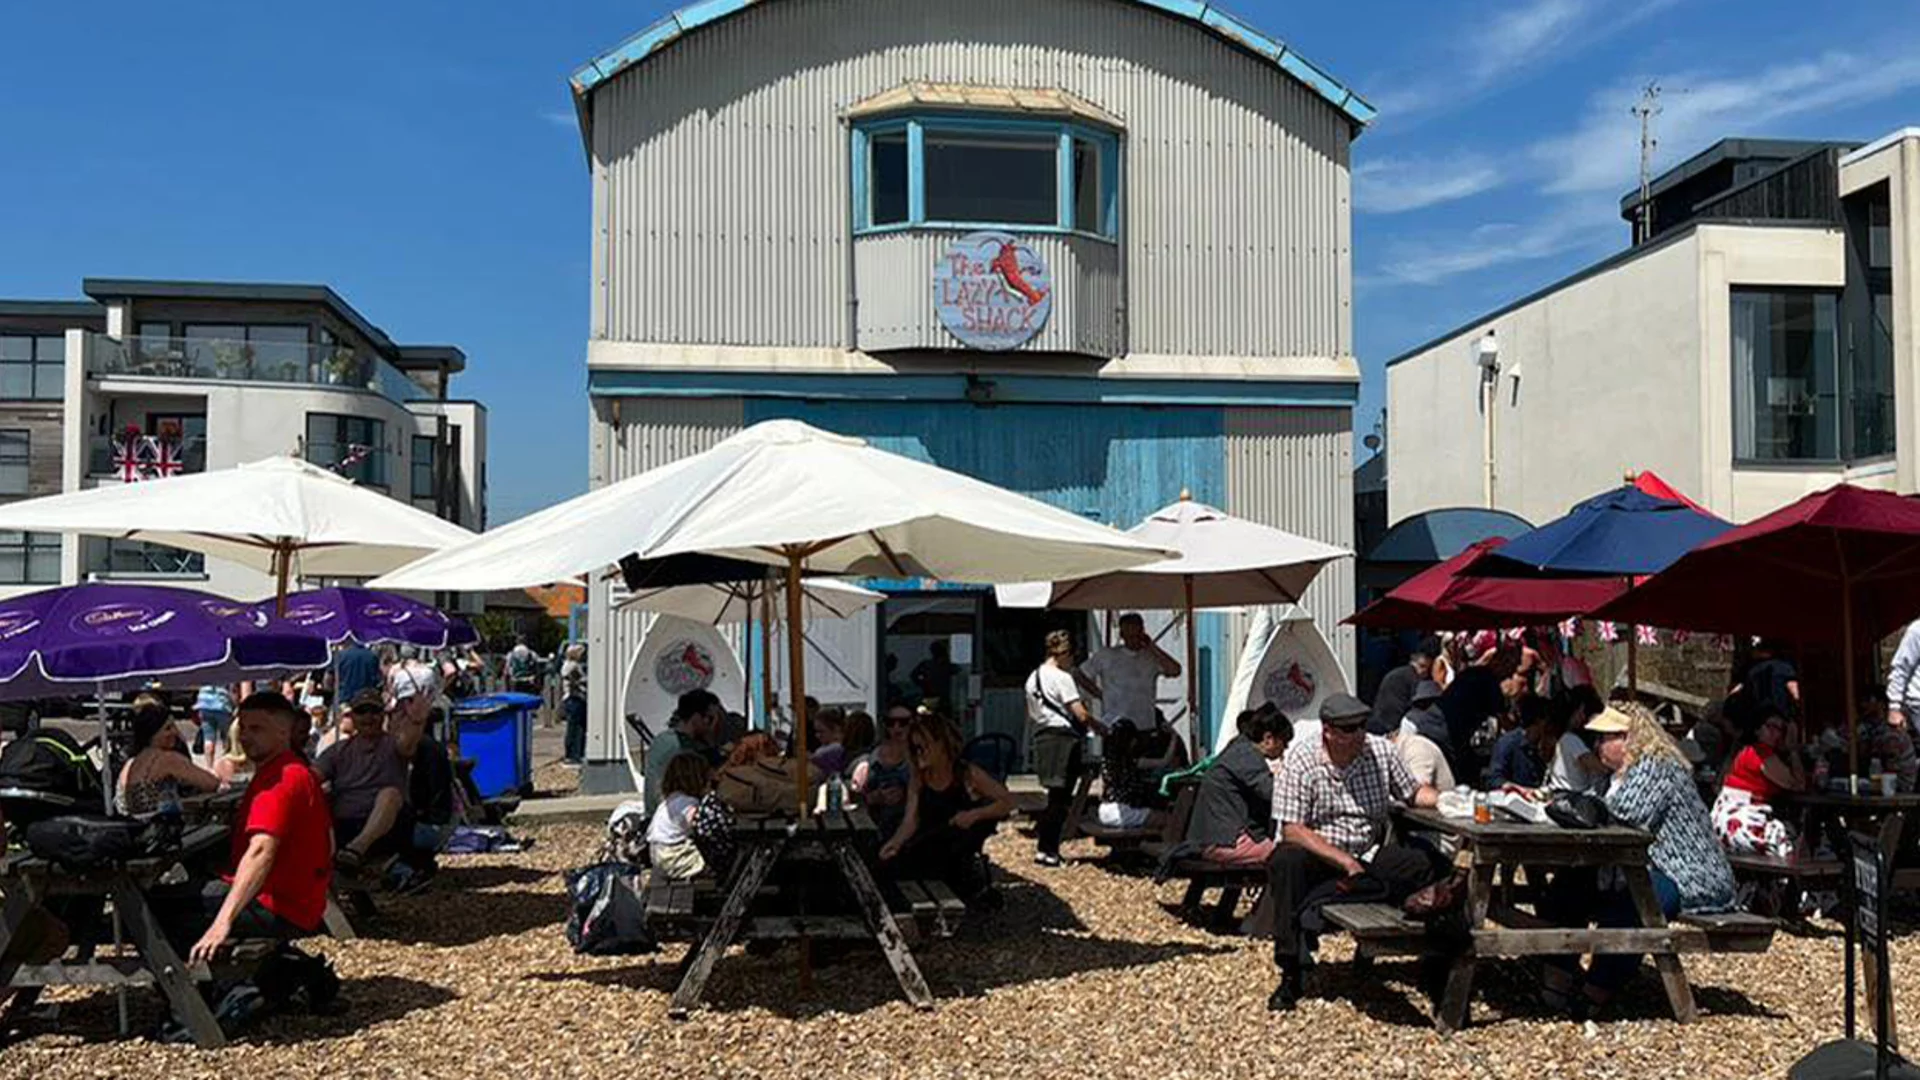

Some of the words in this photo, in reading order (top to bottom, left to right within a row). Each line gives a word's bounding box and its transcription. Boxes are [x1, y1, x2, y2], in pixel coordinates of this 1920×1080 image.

[946, 253, 986, 276] The
[942, 278, 997, 307] LAZY
[962, 305, 1037, 333] SHACK
